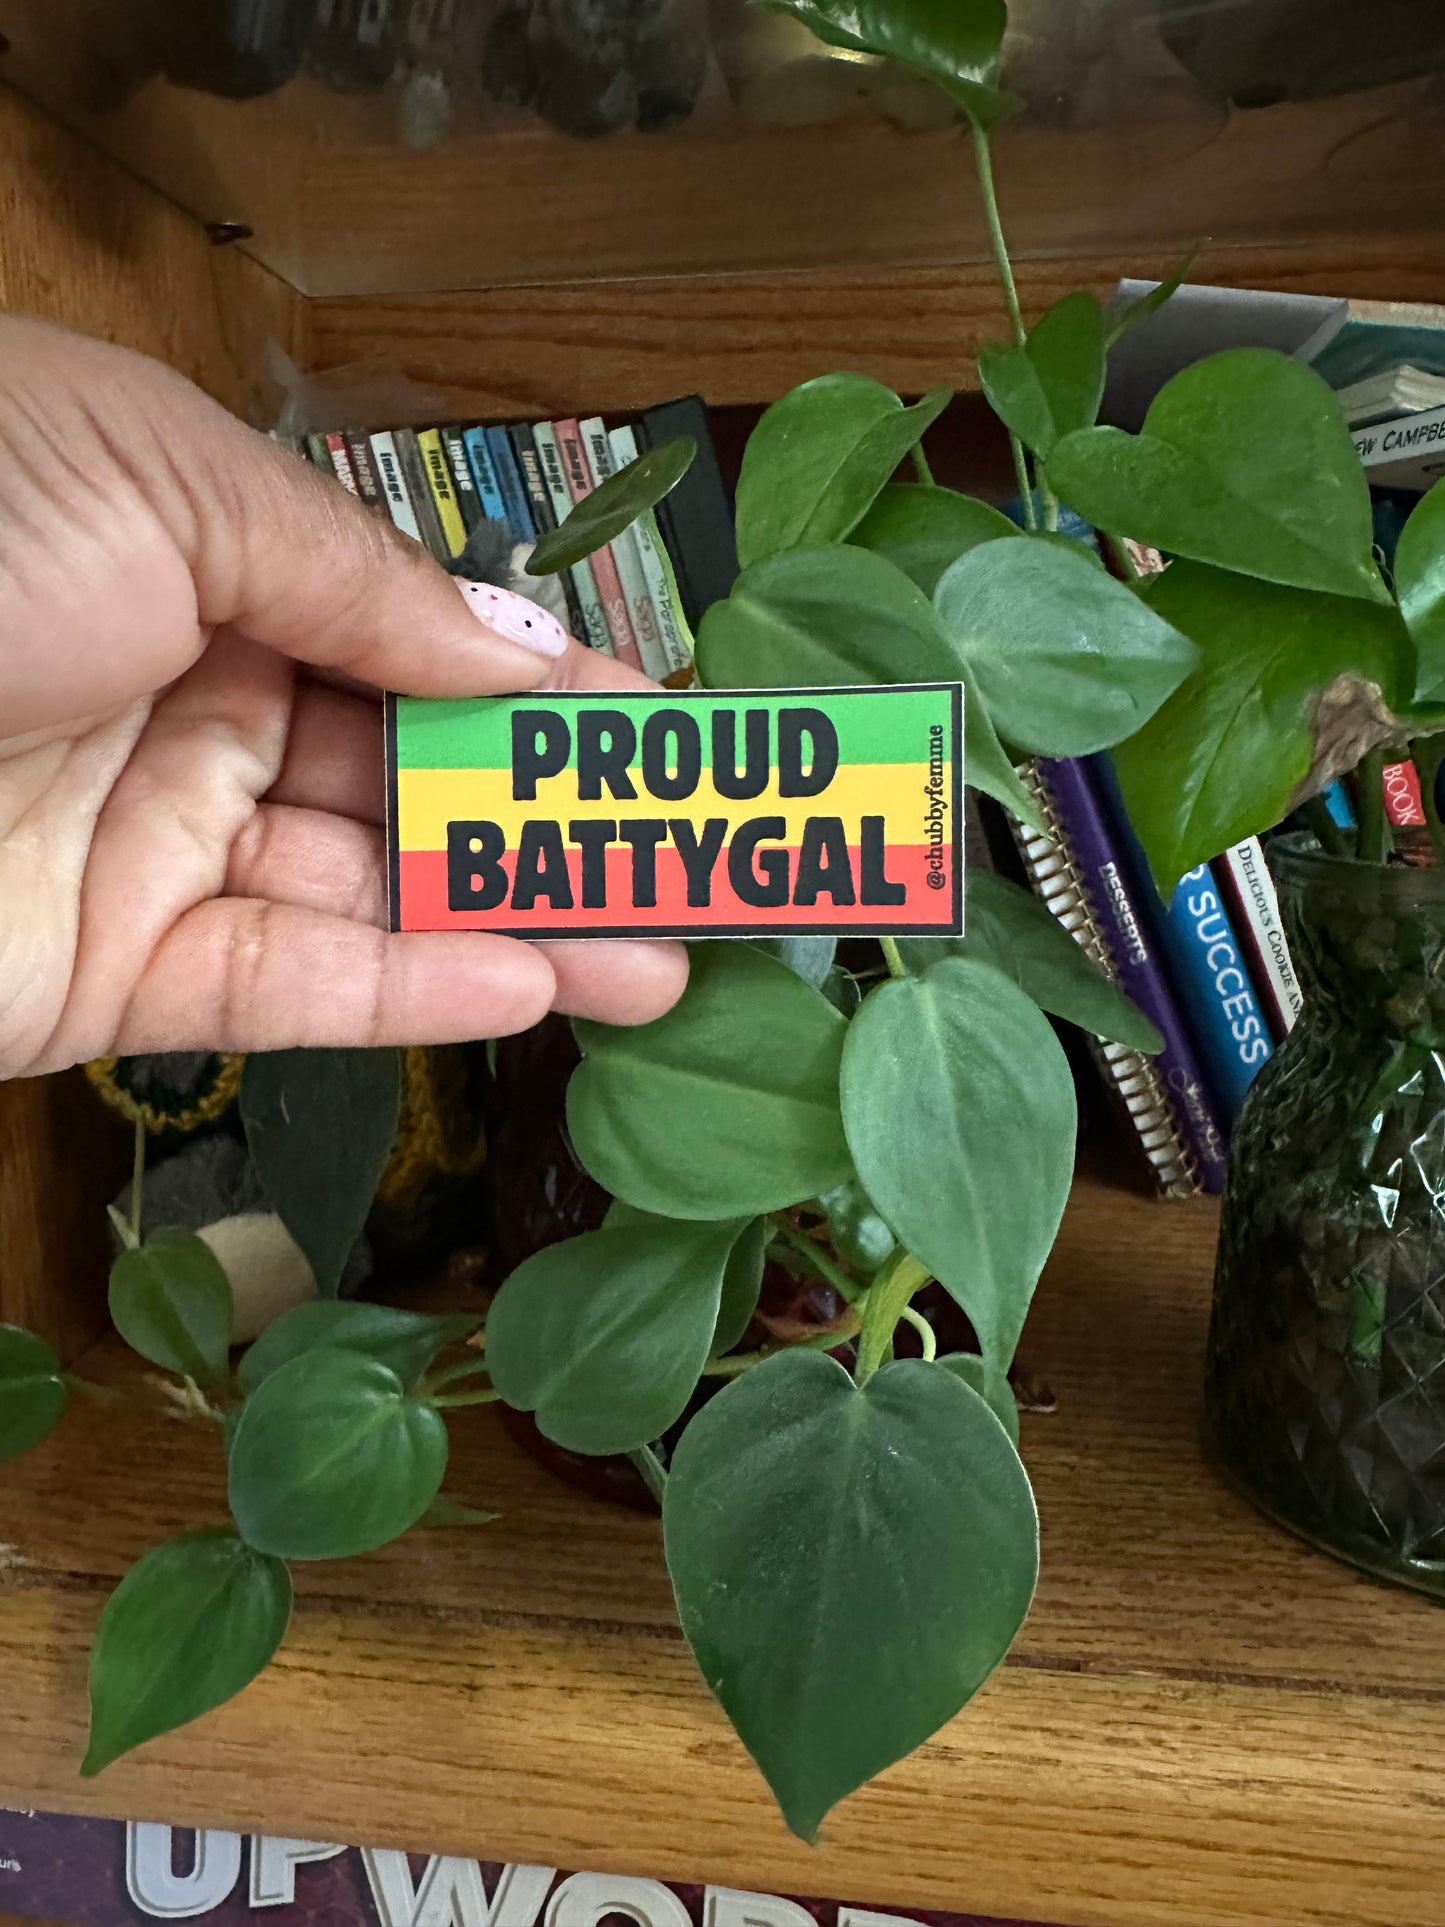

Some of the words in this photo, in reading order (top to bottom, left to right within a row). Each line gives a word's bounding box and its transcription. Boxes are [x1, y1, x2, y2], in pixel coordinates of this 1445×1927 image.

[511, 708, 839, 801] PROUD
[1382, 764, 1420, 826] BOOK
[924, 724, 948, 890] @chubbyfemme
[446, 815, 906, 911] BATTYGAL
[1101, 860, 1147, 966] DESSERTS
[1267, 930, 1295, 990] COOKIE
[1188, 890, 1269, 1064] SUCCESS
